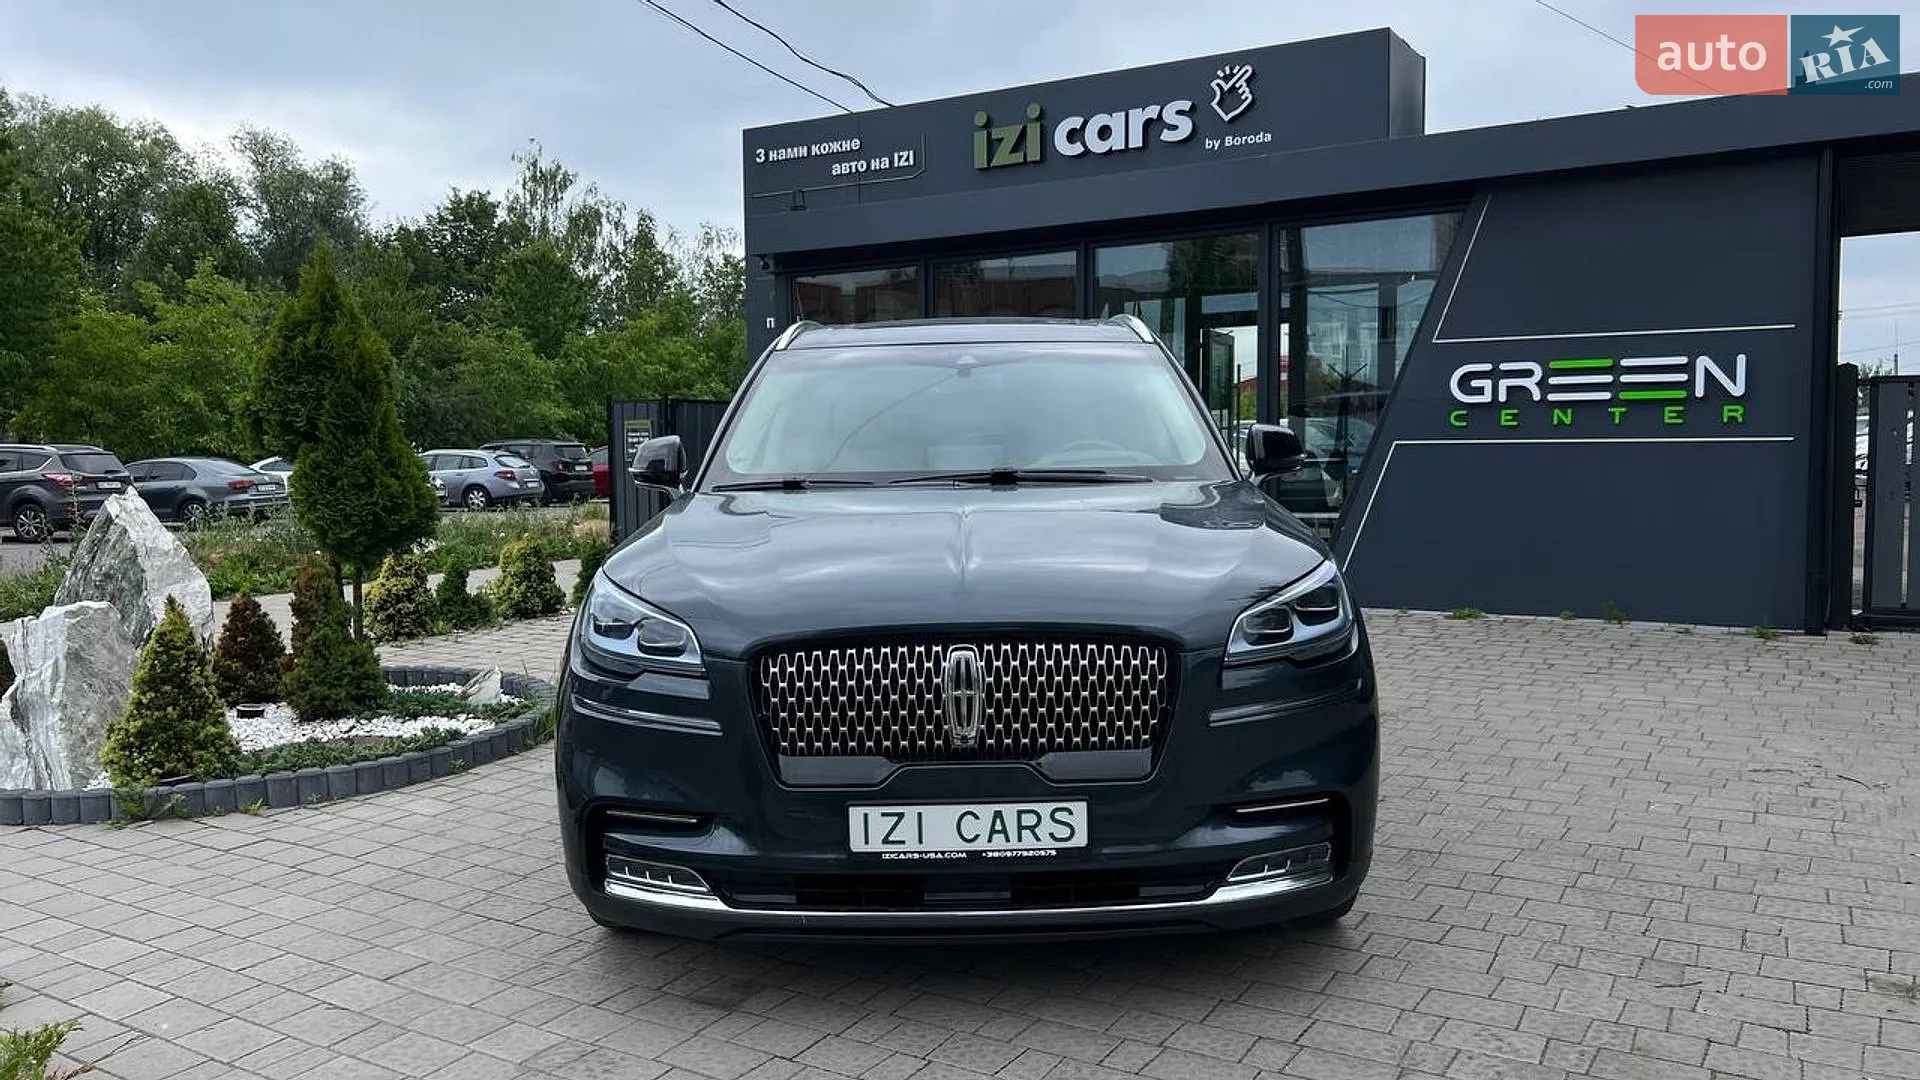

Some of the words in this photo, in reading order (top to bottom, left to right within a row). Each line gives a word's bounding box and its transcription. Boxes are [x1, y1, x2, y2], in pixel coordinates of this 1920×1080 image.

[973, 103, 1041, 169] izi
[1054, 100, 1194, 157] cars
[1205, 137, 1219, 151] by
[1225, 131, 1272, 146] Boroda
[769, 145, 808, 162] нами
[811, 138, 861, 156] кожне
[831, 159, 867, 176] авто
[871, 156, 890, 171] на
[893, 150, 915, 168] IZI
[1449, 353, 1747, 403] GREEN
[1448, 405, 1745, 427] CENTER
[863, 811, 924, 845] IZI
[955, 806, 1076, 844] CARS
